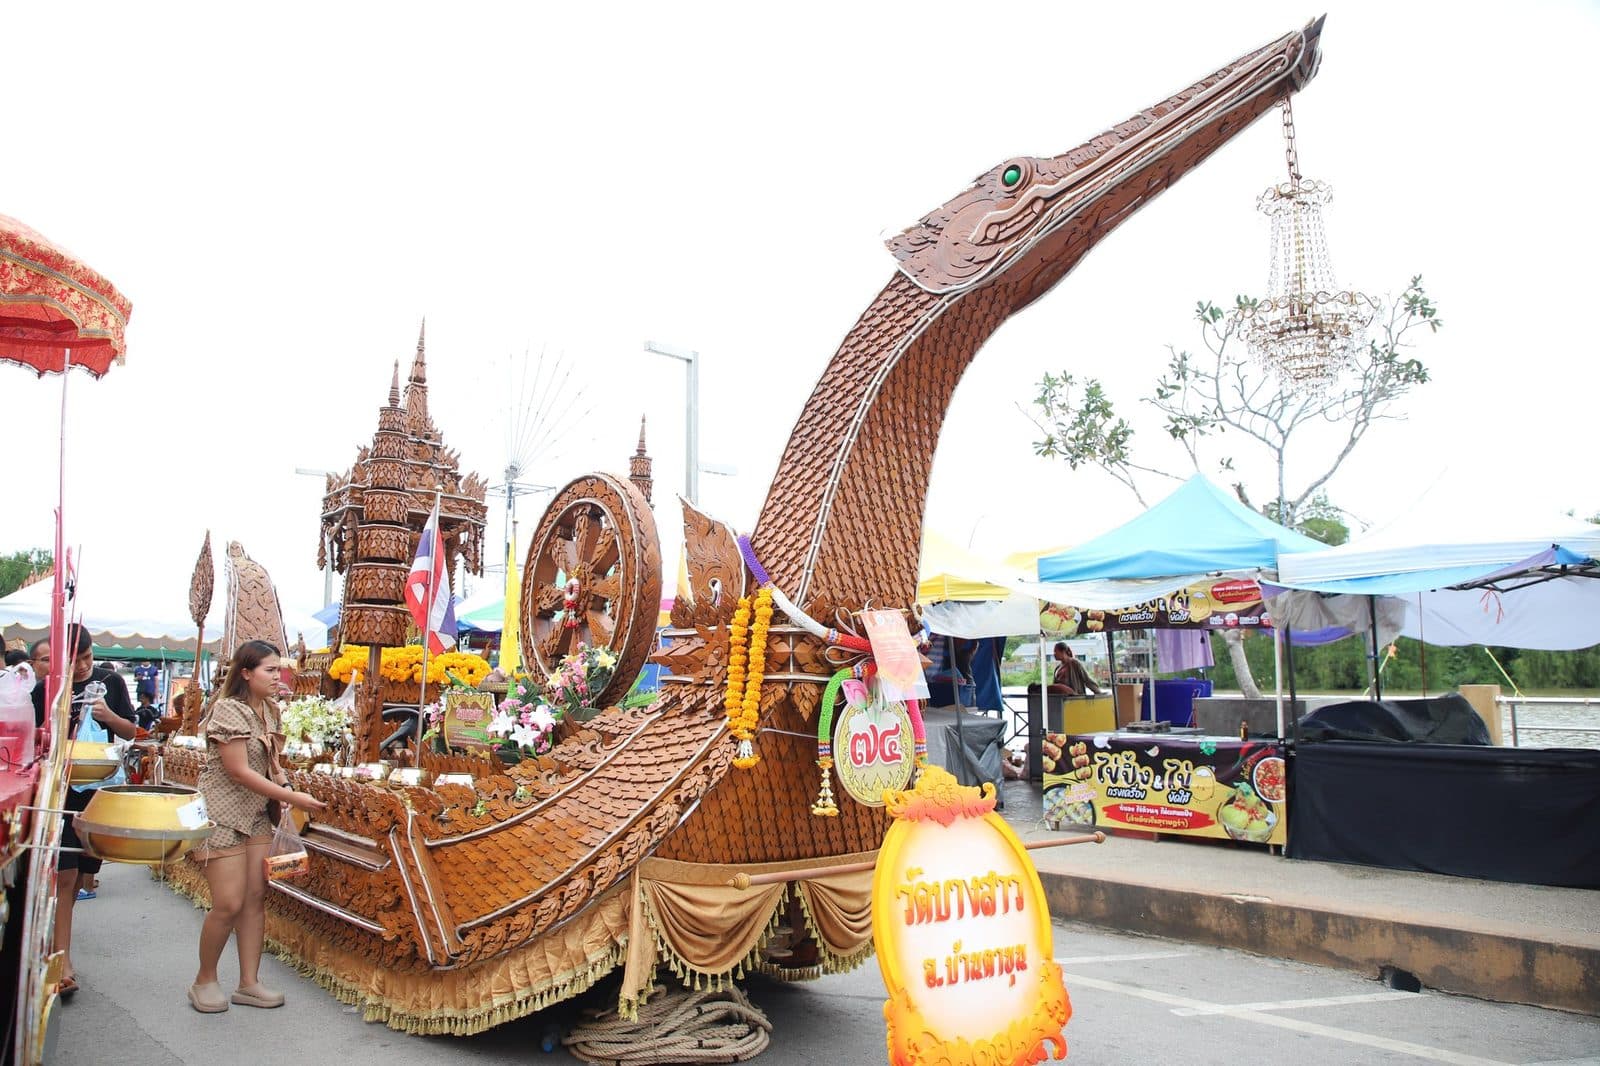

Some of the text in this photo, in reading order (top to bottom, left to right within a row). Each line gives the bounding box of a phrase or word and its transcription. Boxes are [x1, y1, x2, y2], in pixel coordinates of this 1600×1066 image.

[1120, 607, 1154, 621] ทรงเครื่อง
[849, 722, 903, 766] ๗๔
[1096, 753, 1192, 789] ไข่ปิ้ง & ไข่
[1107, 783, 1146, 799] ทรงเครื่อง
[894, 867, 1025, 926] วัดบางสาว
[923, 938, 1028, 989] อ.บ้านตาขุน
